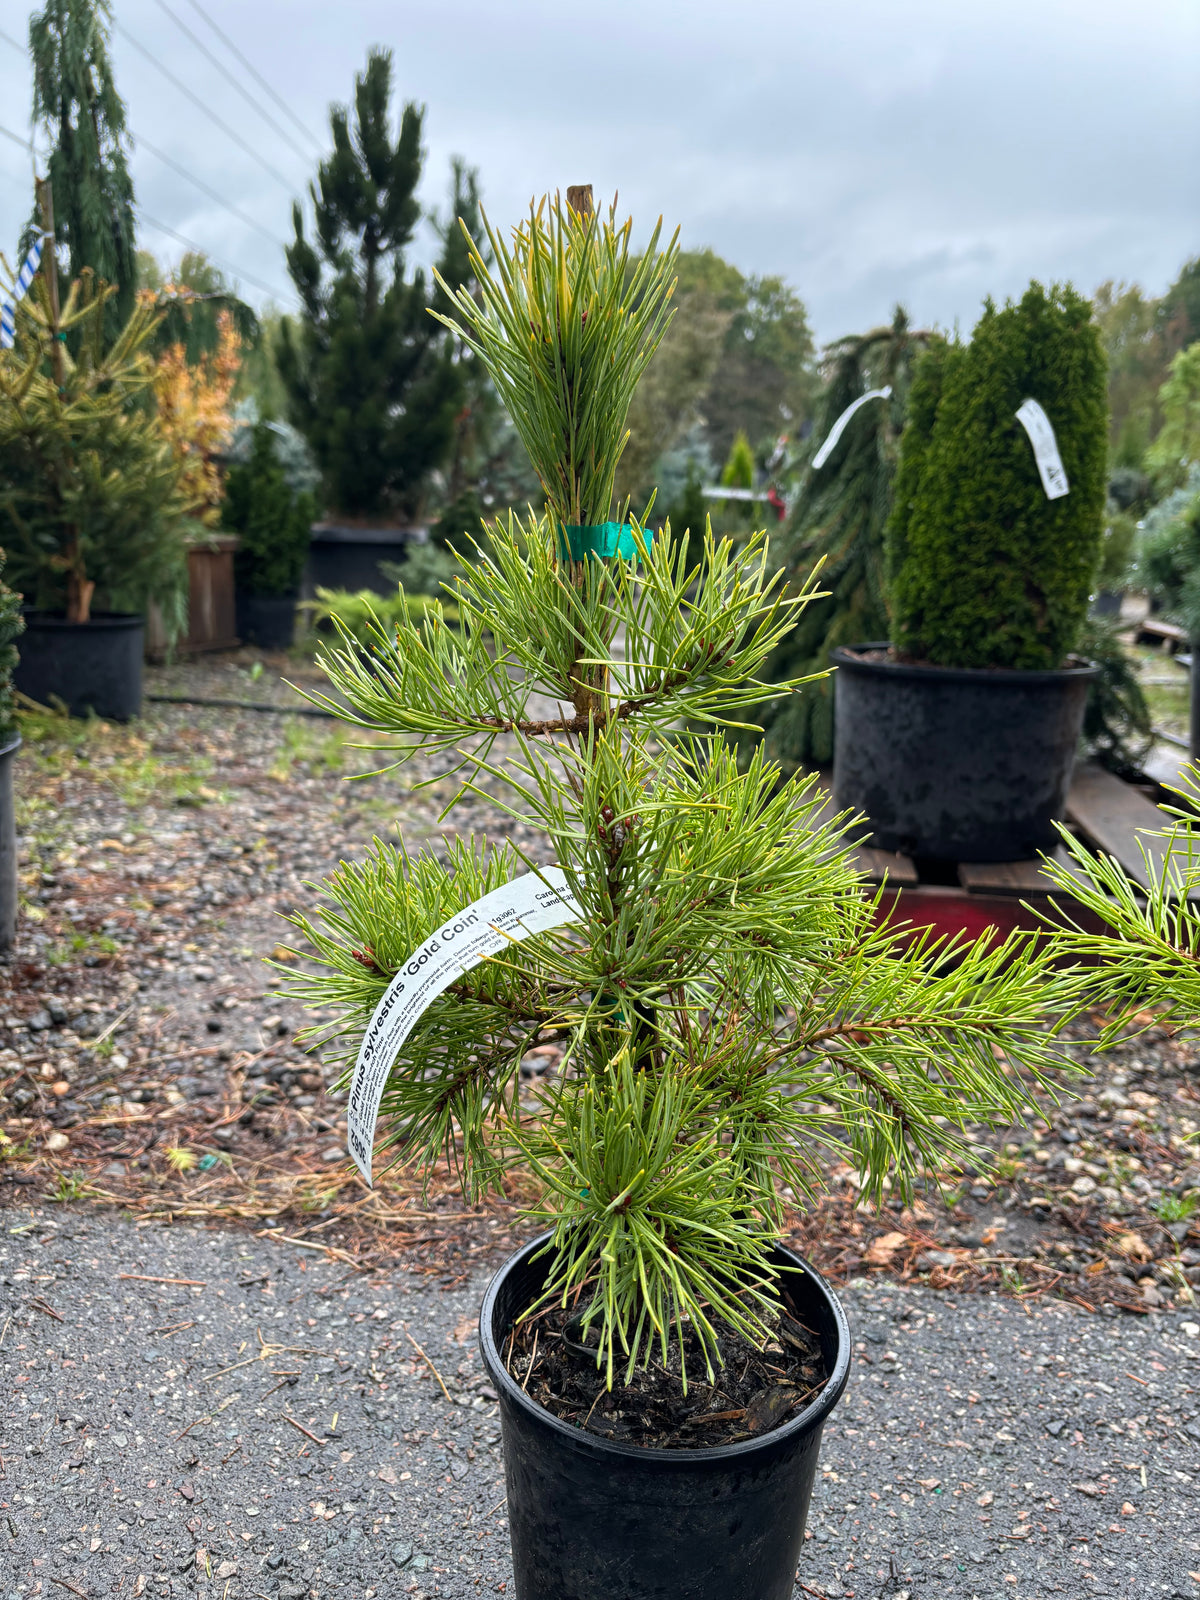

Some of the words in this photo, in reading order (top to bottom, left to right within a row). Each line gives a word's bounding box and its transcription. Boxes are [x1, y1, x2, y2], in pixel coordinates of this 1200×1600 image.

[535, 886, 566, 900] Carona
[541, 893, 575, 908] Landcap
[491, 908, 517, 924] 1g3062
[351, 1063, 366, 1112] Pinus
[364, 982, 405, 1061] sylvestris
[403, 940, 442, 976] 'Gold
[441, 909, 479, 941] Coin'
[374, 1036, 385, 1054] Pine
